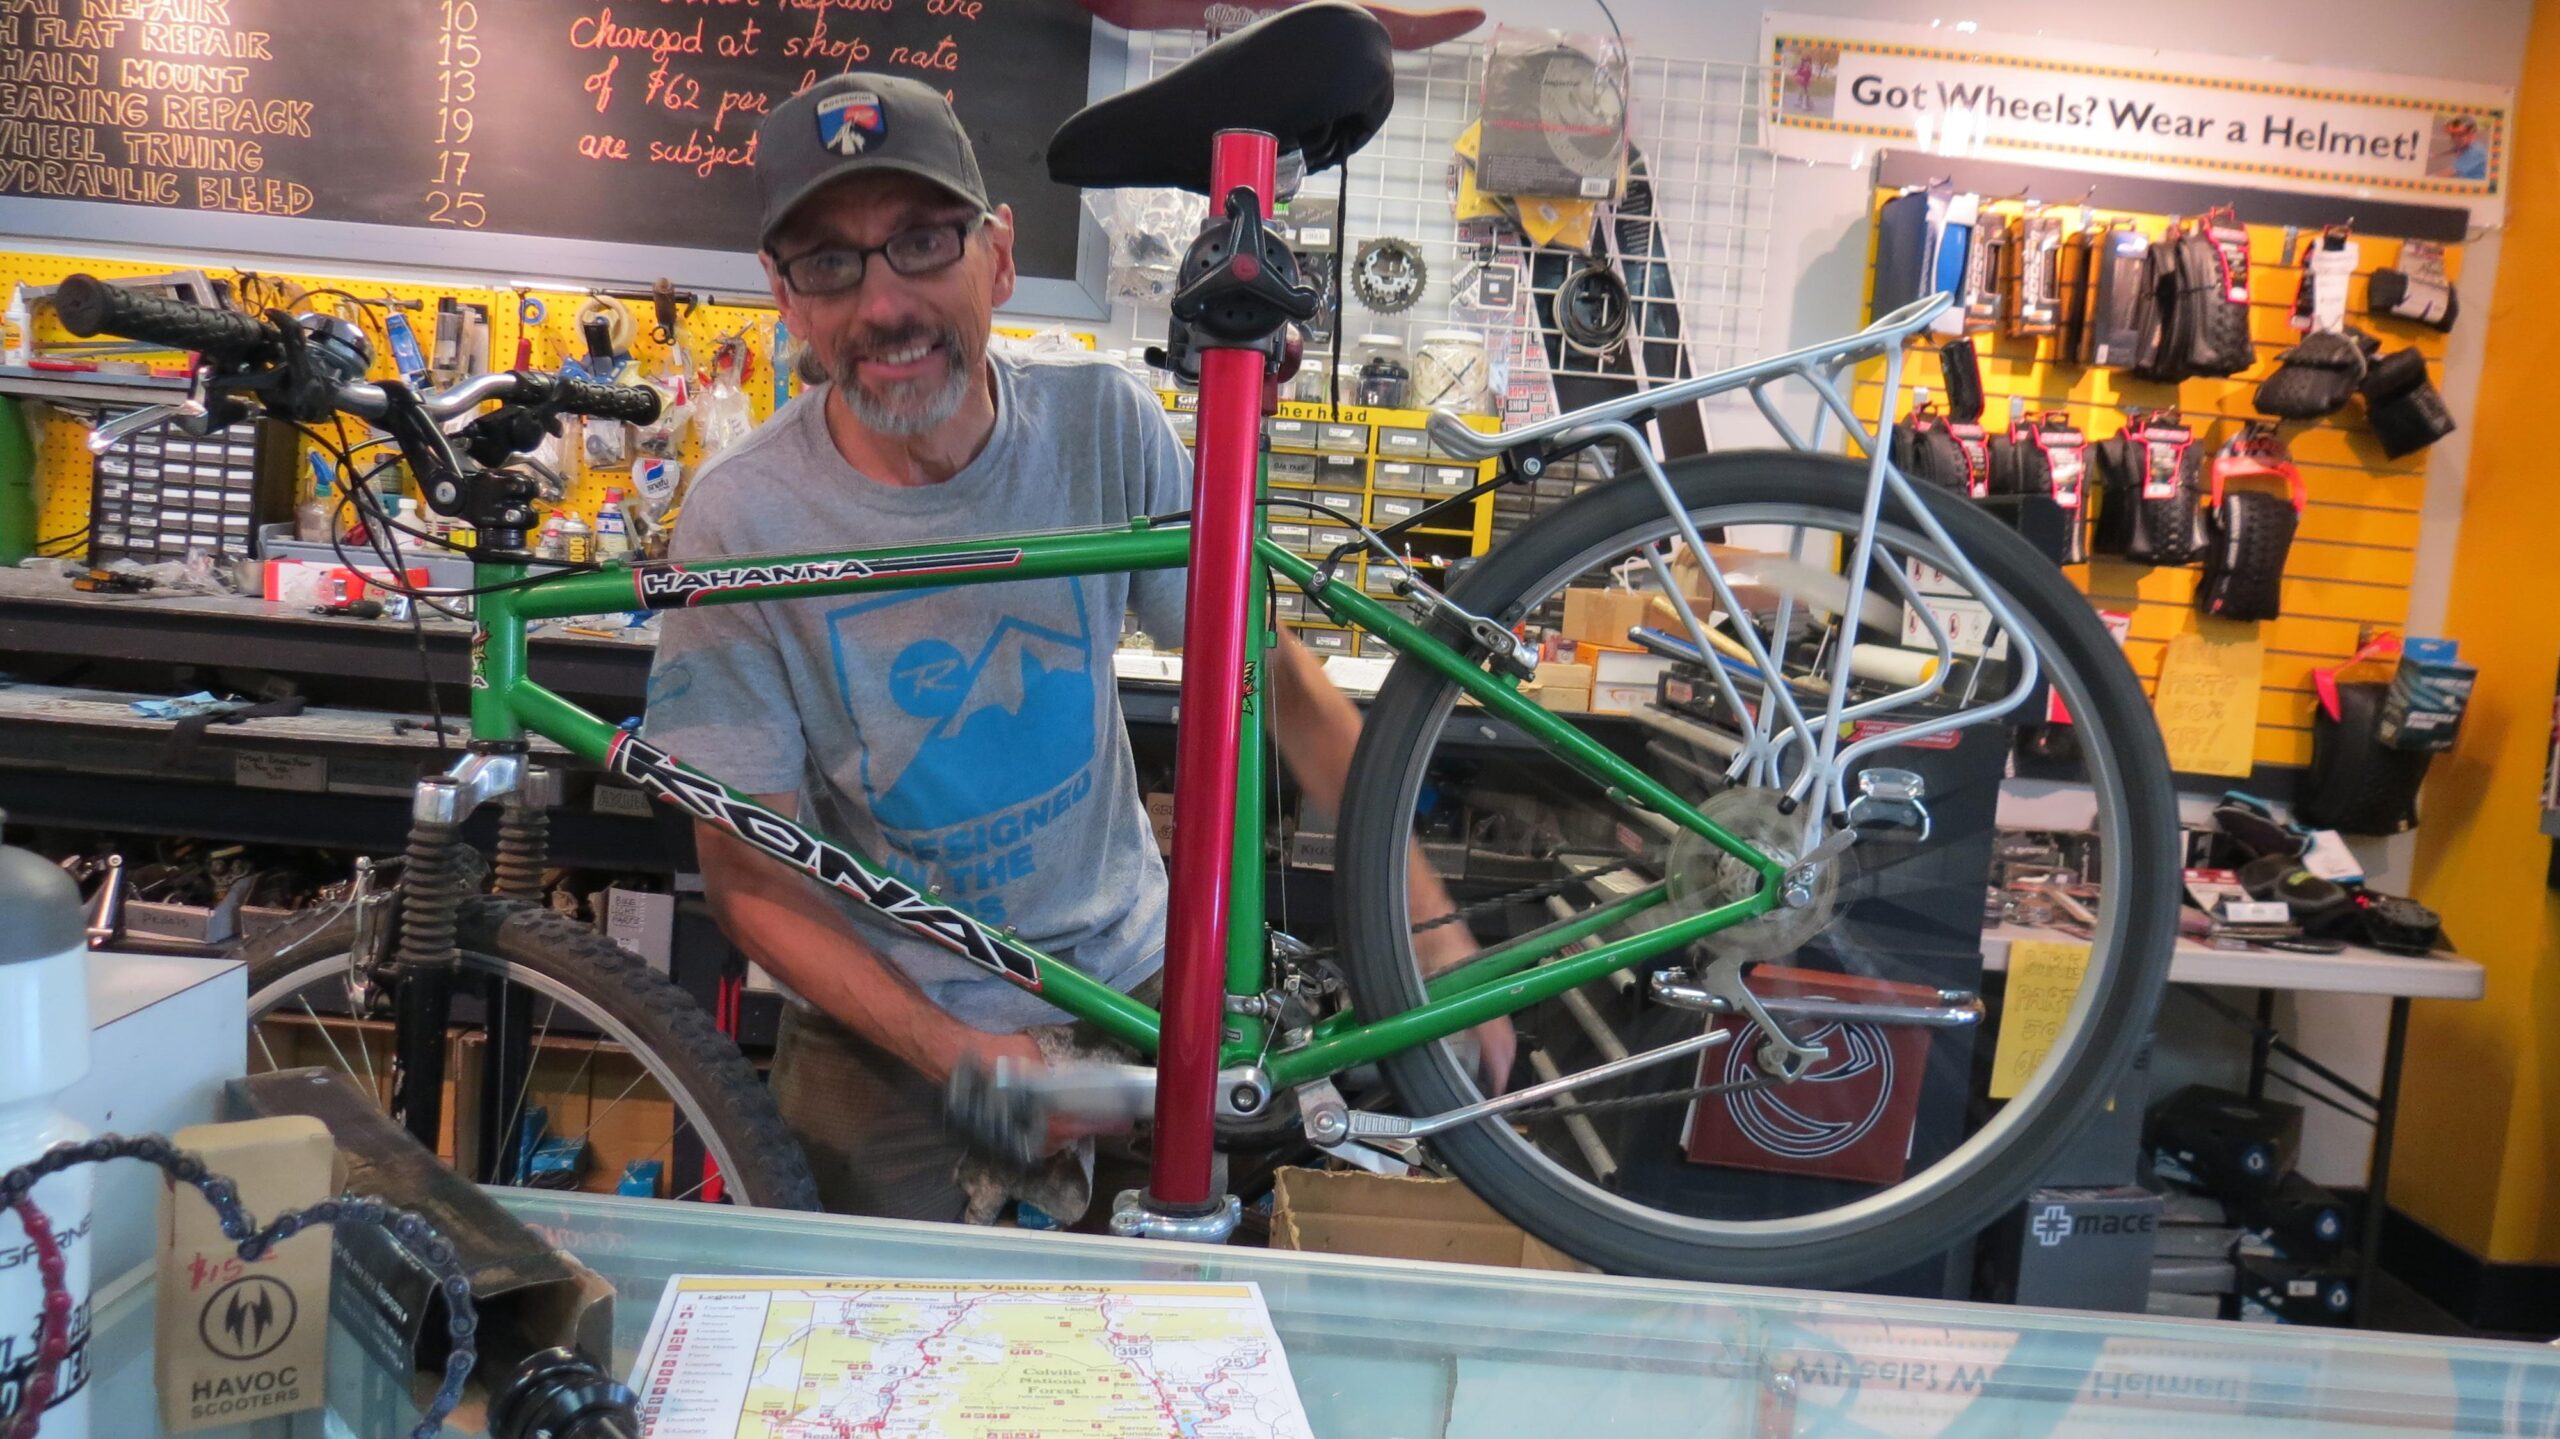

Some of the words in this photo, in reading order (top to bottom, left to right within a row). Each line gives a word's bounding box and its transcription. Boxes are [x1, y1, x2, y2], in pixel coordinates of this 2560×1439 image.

[440, 0, 478, 32] 10
[35, 17, 124, 49] FLAT
[142, 22, 272, 61] REPAIR
[438, 35, 482, 68] 15
[718, 18, 761, 57] at
[120, 58, 249, 94] MOUNT
[436, 69, 476, 103] 13
[584, 56, 618, 113] of
[645, 57, 700, 110] $62
[163, 94, 314, 138] REPACK
[434, 107, 474, 144] 19
[1851, 73, 1927, 111] Got
[1937, 79, 2098, 127] Wheels?
[2108, 98, 2215, 139] Wear
[2226, 119, 2247, 143] a
[2262, 115, 2420, 160] Helmet!
[123, 131, 264, 173] TRUING
[431, 150, 471, 186] 17
[579, 133, 632, 160] are
[650, 129, 758, 178] subject
[198, 175, 314, 215] BLEED
[425, 191, 487, 228] 25
[643, 558, 874, 595] HAHANNA
[621, 739, 1036, 985] KONA
[946, 844, 1037, 896] THE
[825, 1282, 886, 1290] Ferry
[894, 1282, 971, 1291] County
[980, 1284, 1054, 1292] Visitor
[1061, 1285, 1111, 1293] Map
[1117, 1346, 1149, 1356] 395
[1221, 1357, 1245, 1368] 25
[191, 1366, 298, 1402] HAVOC
[887, 1366, 909, 1376] 21
[1020, 1377, 1087, 1385] National
[1023, 1368, 1080, 1376] Colville
[191, 1387, 300, 1419] SCOOTERS
[1027, 1386, 1081, 1395] Forest
